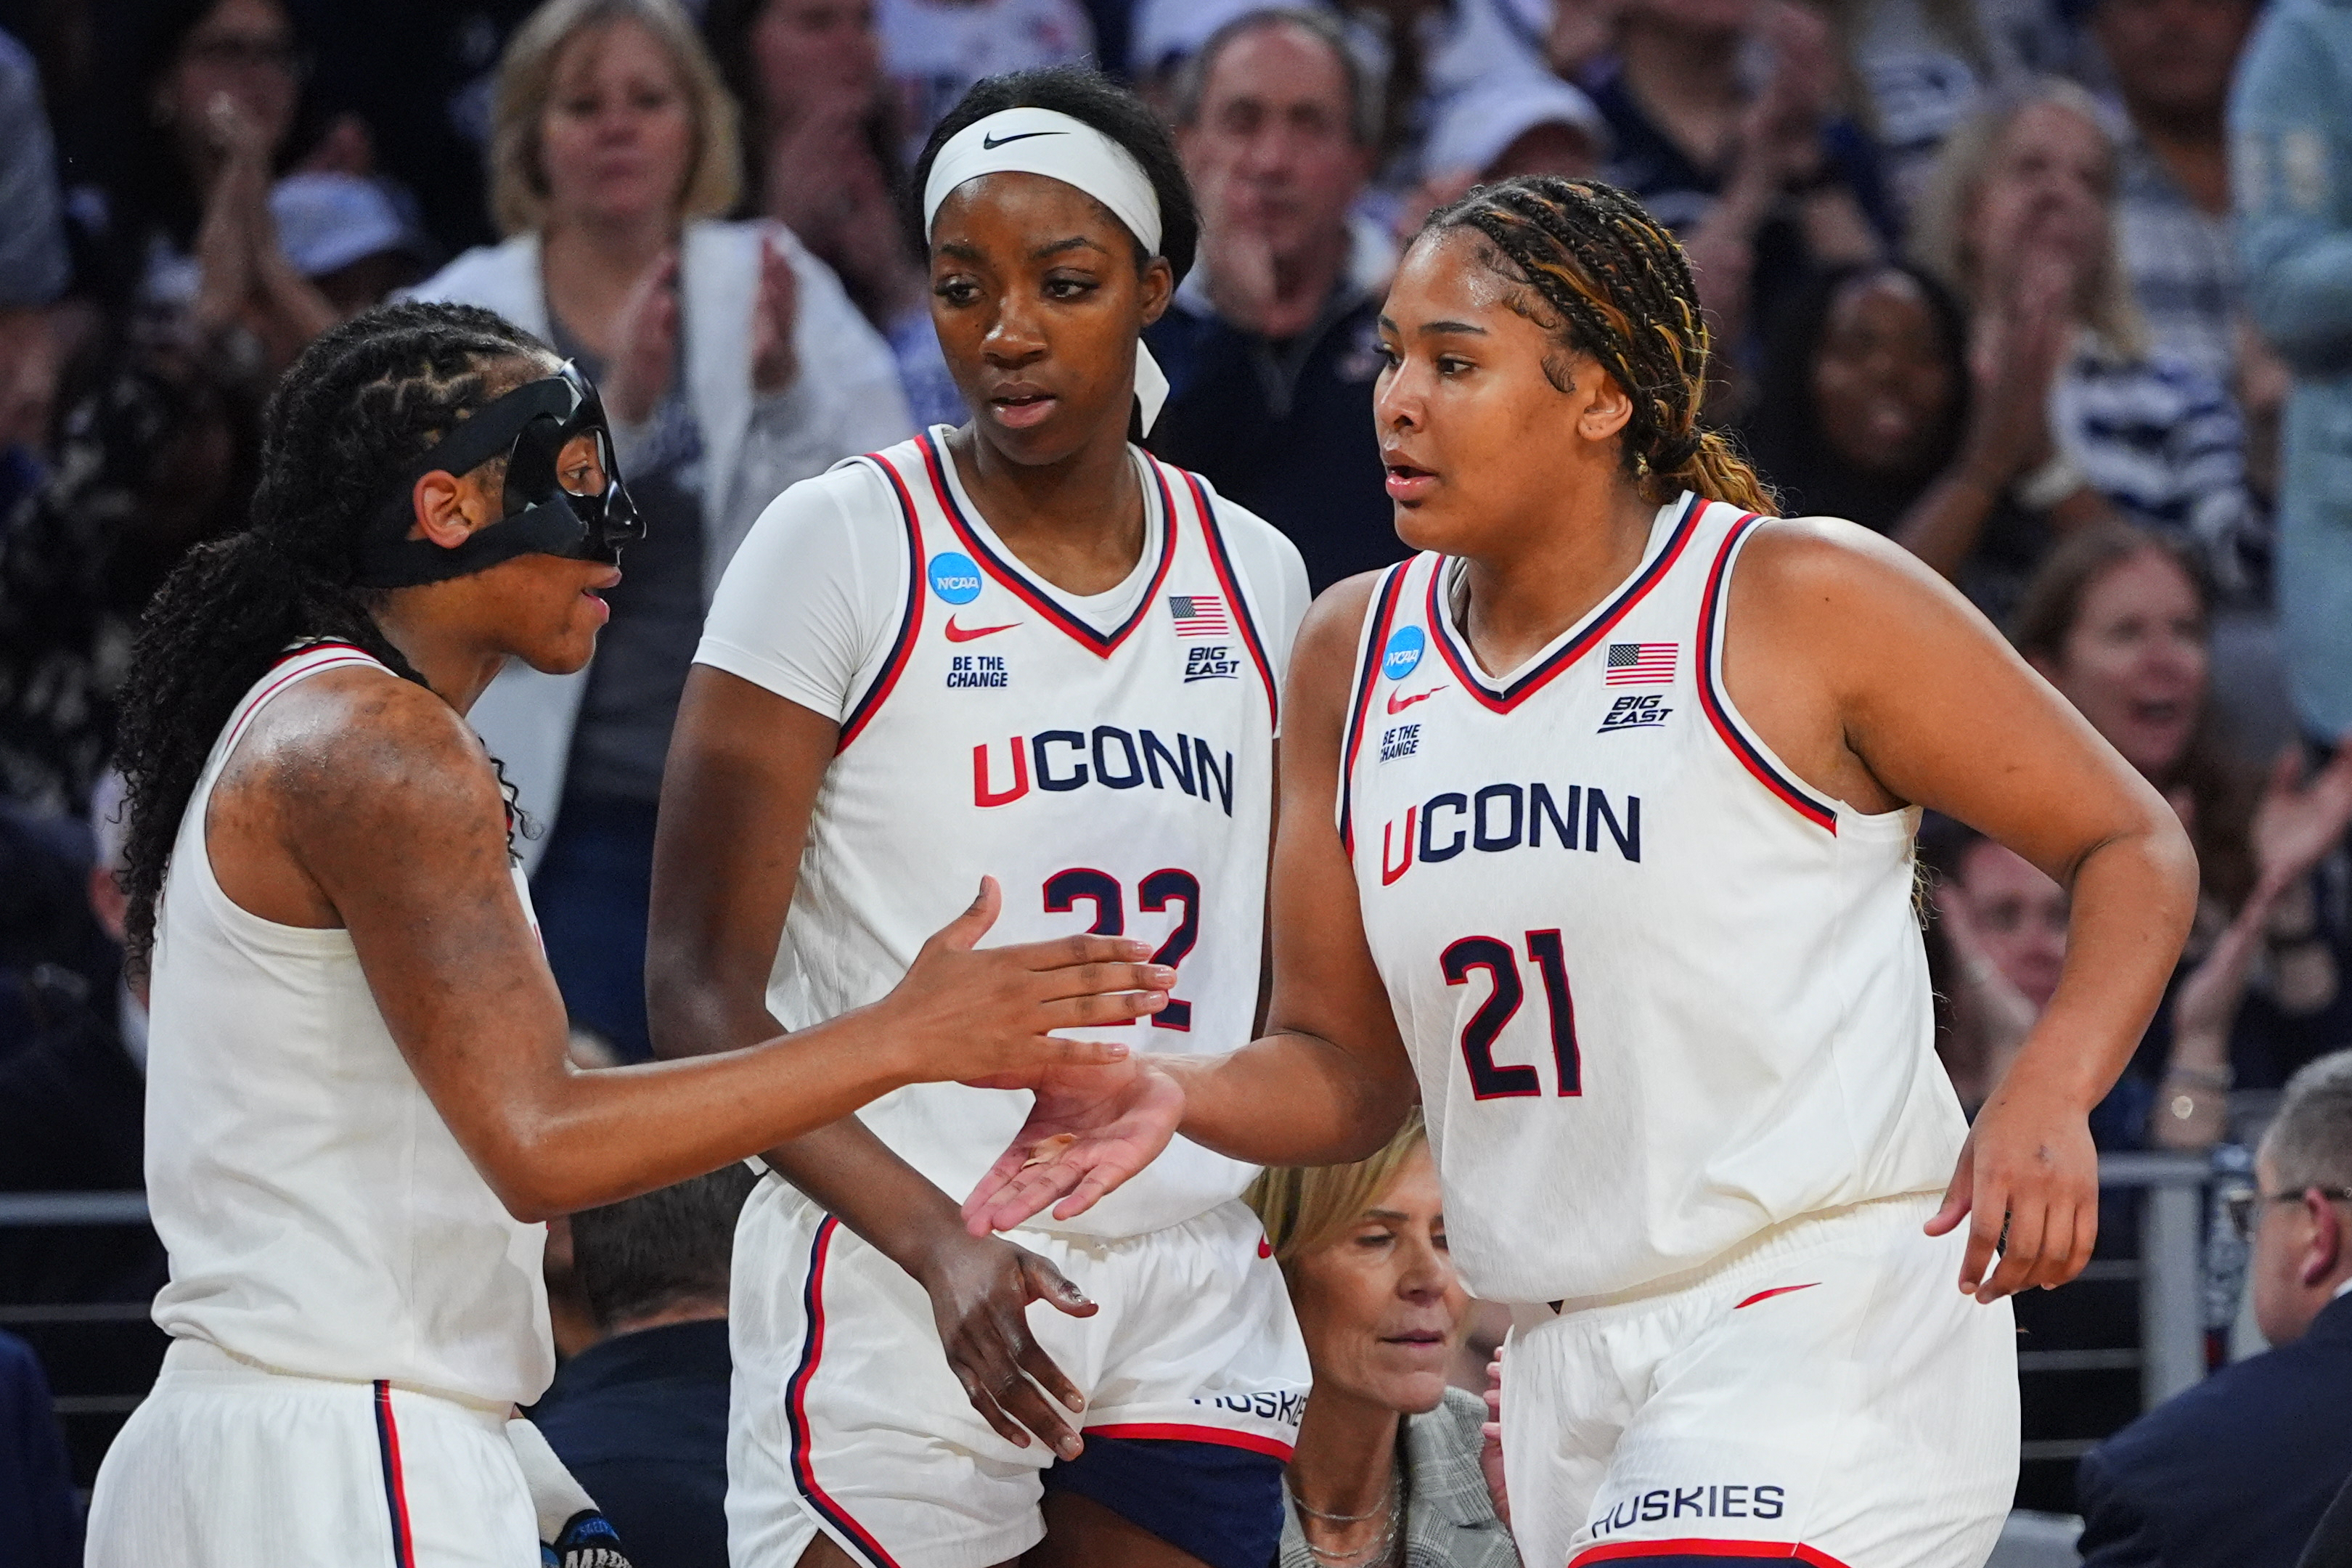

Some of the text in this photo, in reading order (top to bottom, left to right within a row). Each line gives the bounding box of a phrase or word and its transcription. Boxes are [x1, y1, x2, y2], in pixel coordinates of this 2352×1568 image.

[937, 576, 979, 590] NCAA
[1189, 647, 1228, 661] BIG
[1386, 649, 1419, 666] NCAA
[952, 656, 1005, 671] BE THE
[1185, 661, 1240, 675] EAST
[947, 672, 1008, 687] CHANGE
[1612, 695, 1664, 711] BIG
[1602, 709, 1674, 725] EAST
[1383, 724, 1421, 746] BE THE
[973, 725, 1233, 819] UCONN
[1382, 783, 1641, 887] UCONN
[1440, 928, 1582, 1101] 21
[1591, 1485, 1785, 1538] HUSKIES
